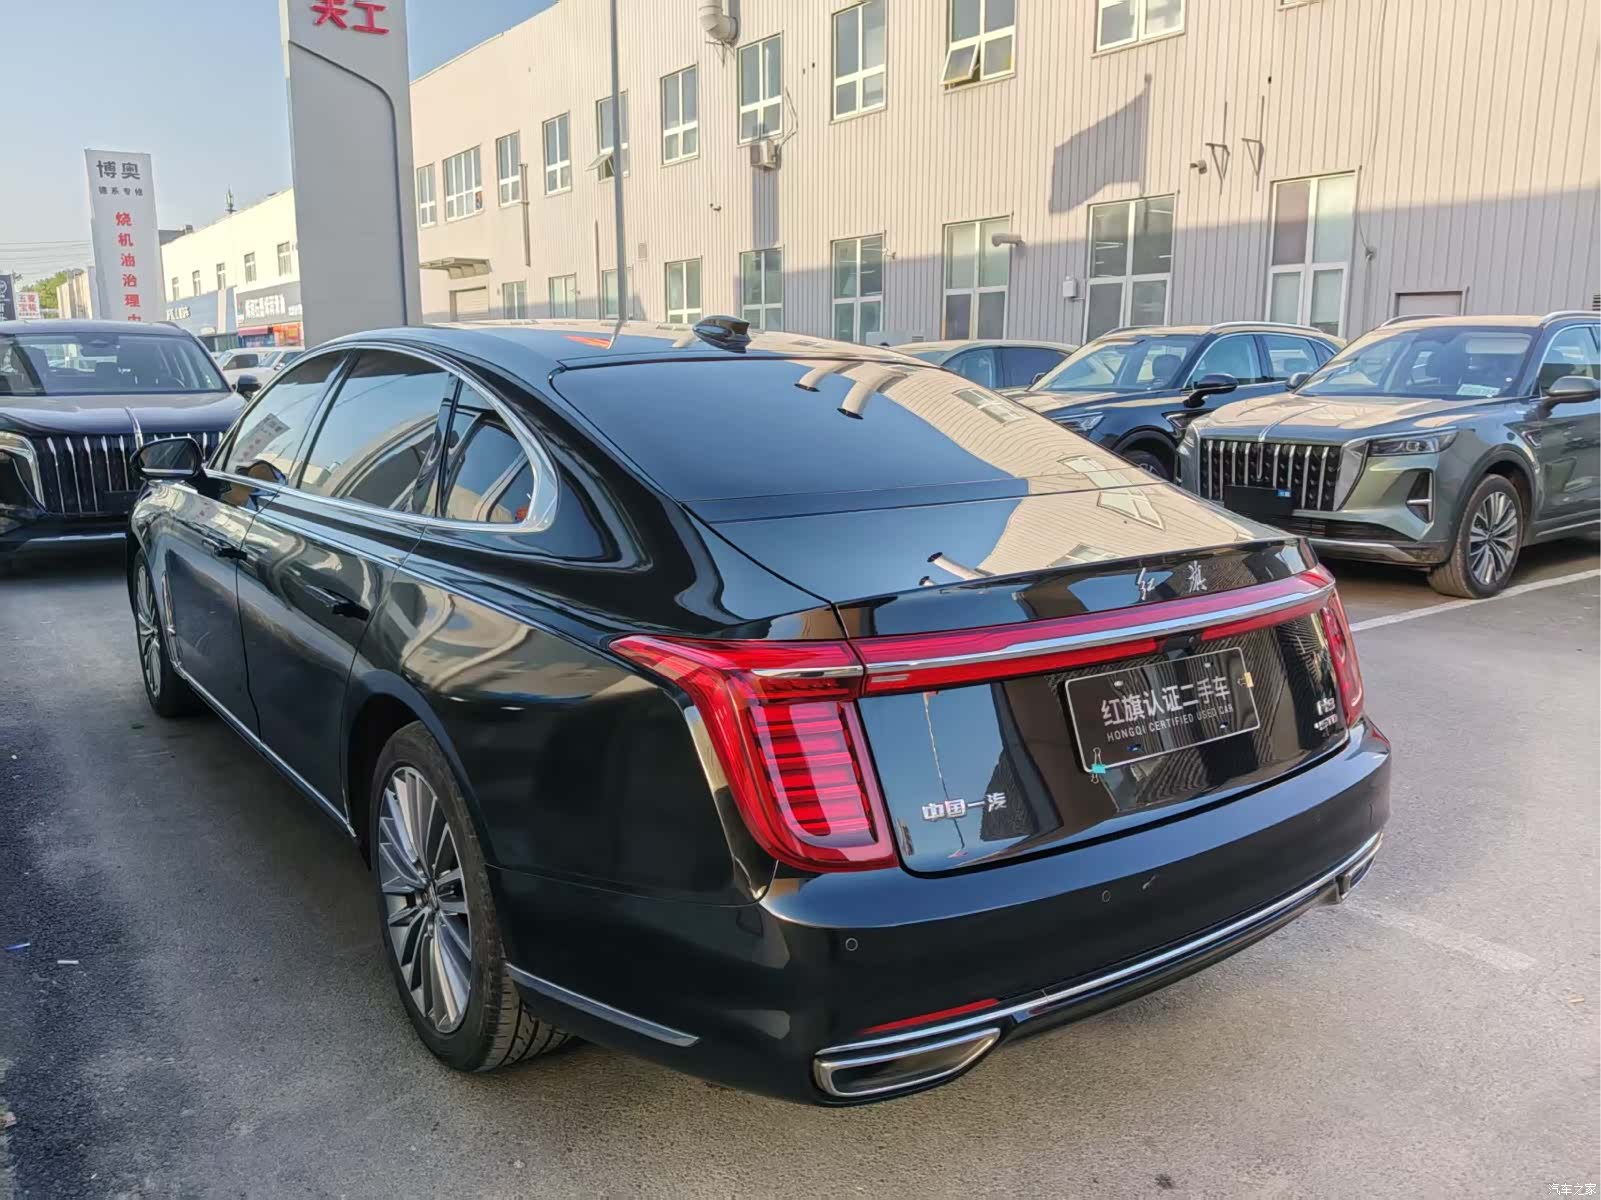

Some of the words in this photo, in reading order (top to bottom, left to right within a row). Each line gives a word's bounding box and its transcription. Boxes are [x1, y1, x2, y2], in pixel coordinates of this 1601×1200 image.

[96, 160, 141, 180] 博奥
[1101, 676, 1231, 726] 红旗认证二手车
[1106, 724, 1146, 742] HONGQI
[1149, 713, 1194, 732] CERTIFIED
[1197, 708, 1218, 721] USED
[1219, 705, 1234, 715] CAR
[922, 792, 1007, 821] 中国一汽
